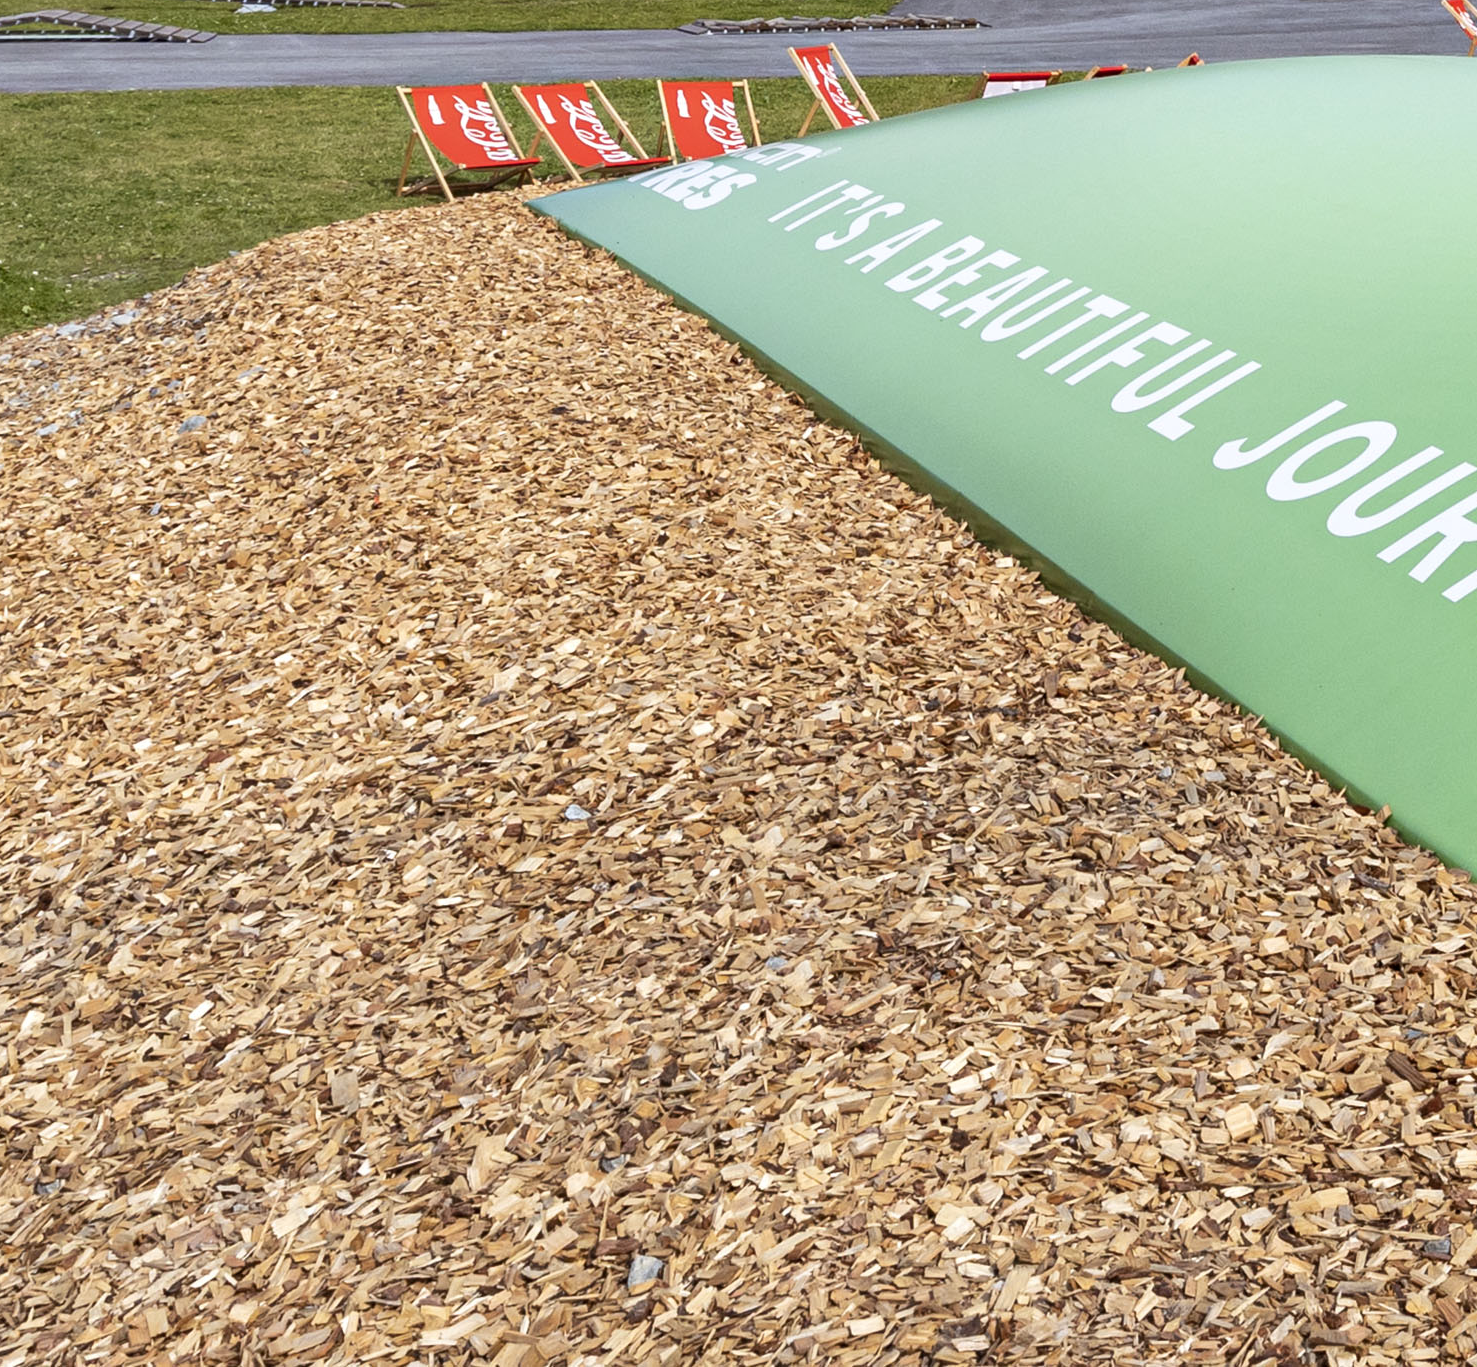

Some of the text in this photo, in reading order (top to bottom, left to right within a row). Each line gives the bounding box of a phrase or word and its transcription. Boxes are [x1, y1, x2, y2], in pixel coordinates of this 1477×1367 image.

[767, 179, 906, 251] IT'S
[844, 218, 943, 274] A
[884, 234, 1262, 441] BEAUTIFUL
